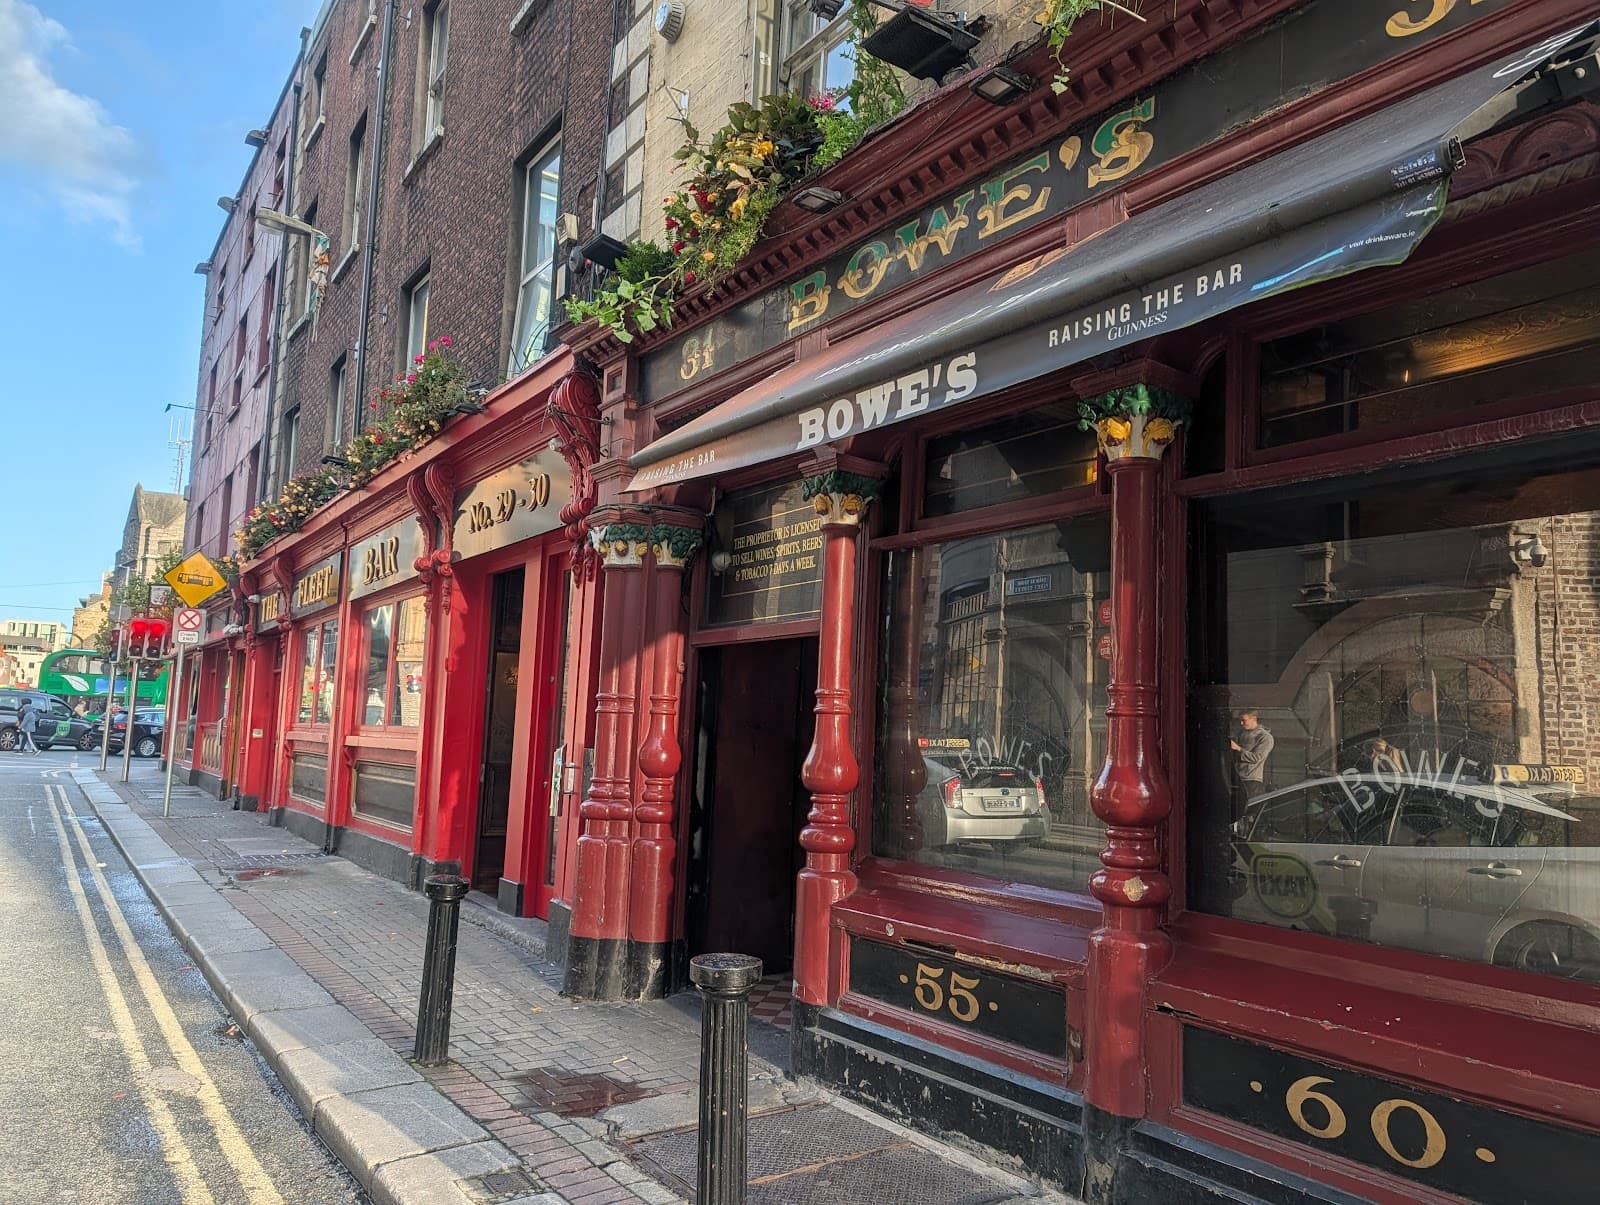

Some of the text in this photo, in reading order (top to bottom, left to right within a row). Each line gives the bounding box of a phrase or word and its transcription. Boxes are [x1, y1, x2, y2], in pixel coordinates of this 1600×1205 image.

[788, 96, 1155, 330] BOWE'S
[1349, 229, 1416, 249] visit drinkaware.ie
[1049, 263, 1243, 347] RAISING THE BAR
[1107, 311, 1168, 341] GUINNESS
[797, 352, 977, 449] BOWE'S
[679, 456, 695, 472] THE
[699, 450, 715, 466] BAR
[734, 536, 746, 549] THE
[746, 528, 782, 547] PROPRIETOR
[783, 524, 790, 538] IS
[732, 553, 741, 566] TO
[741, 551, 754, 565] SELL
[741, 564, 769, 581] TOBACCO
[774, 560, 789, 575] DAYS
[790, 560, 796, 572] A
[261, 536, 399, 623] THE FLEET BAR
